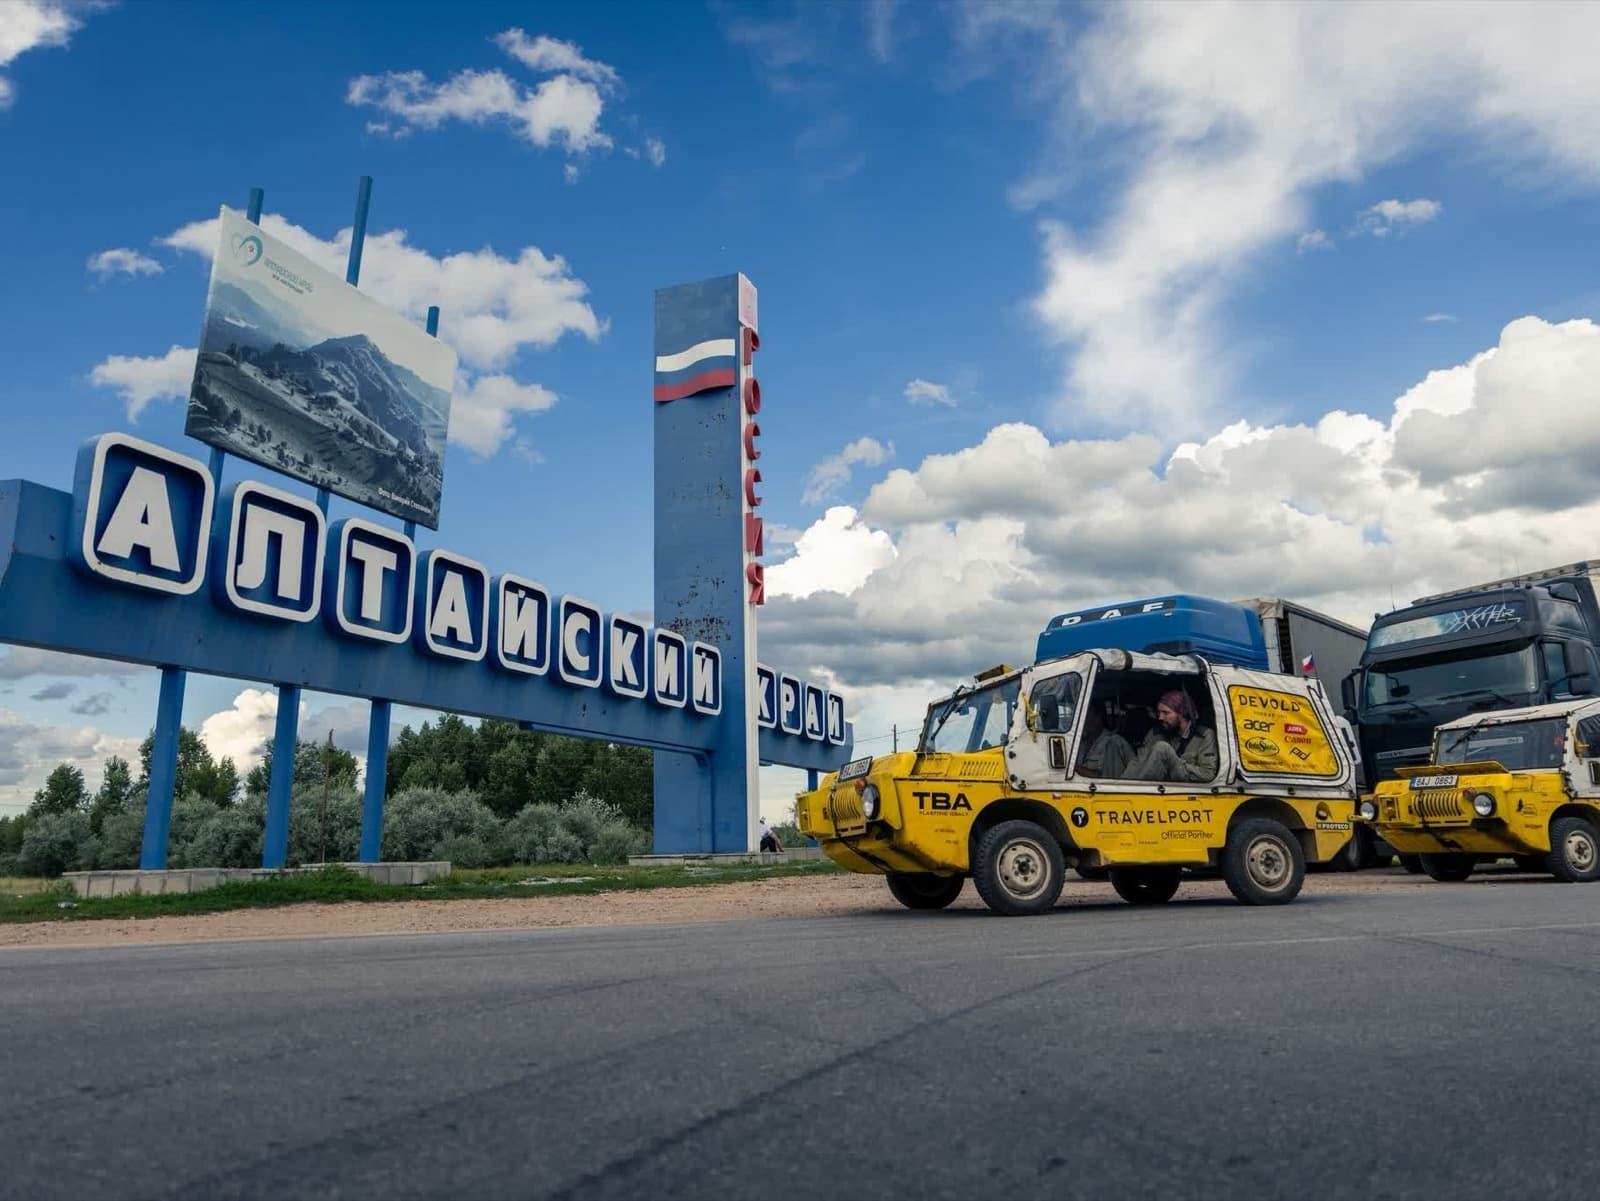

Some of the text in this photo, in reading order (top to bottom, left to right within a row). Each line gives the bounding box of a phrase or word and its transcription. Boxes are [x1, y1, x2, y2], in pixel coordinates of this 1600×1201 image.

[744, 327, 764, 605] РОССИЯ
[96, 465, 840, 737] АЛТАЙСКИЙ КРАЙ
[1061, 601, 1164, 627] DAF
[1238, 694, 1301, 712] DEVOLD
[1243, 719, 1275, 733] acer
[1284, 735, 1312, 745] Canon
[912, 791, 973, 811] TBA
[1095, 809, 1213, 825] TRAVELPORT
[1160, 830, 1214, 840] Official Partner
